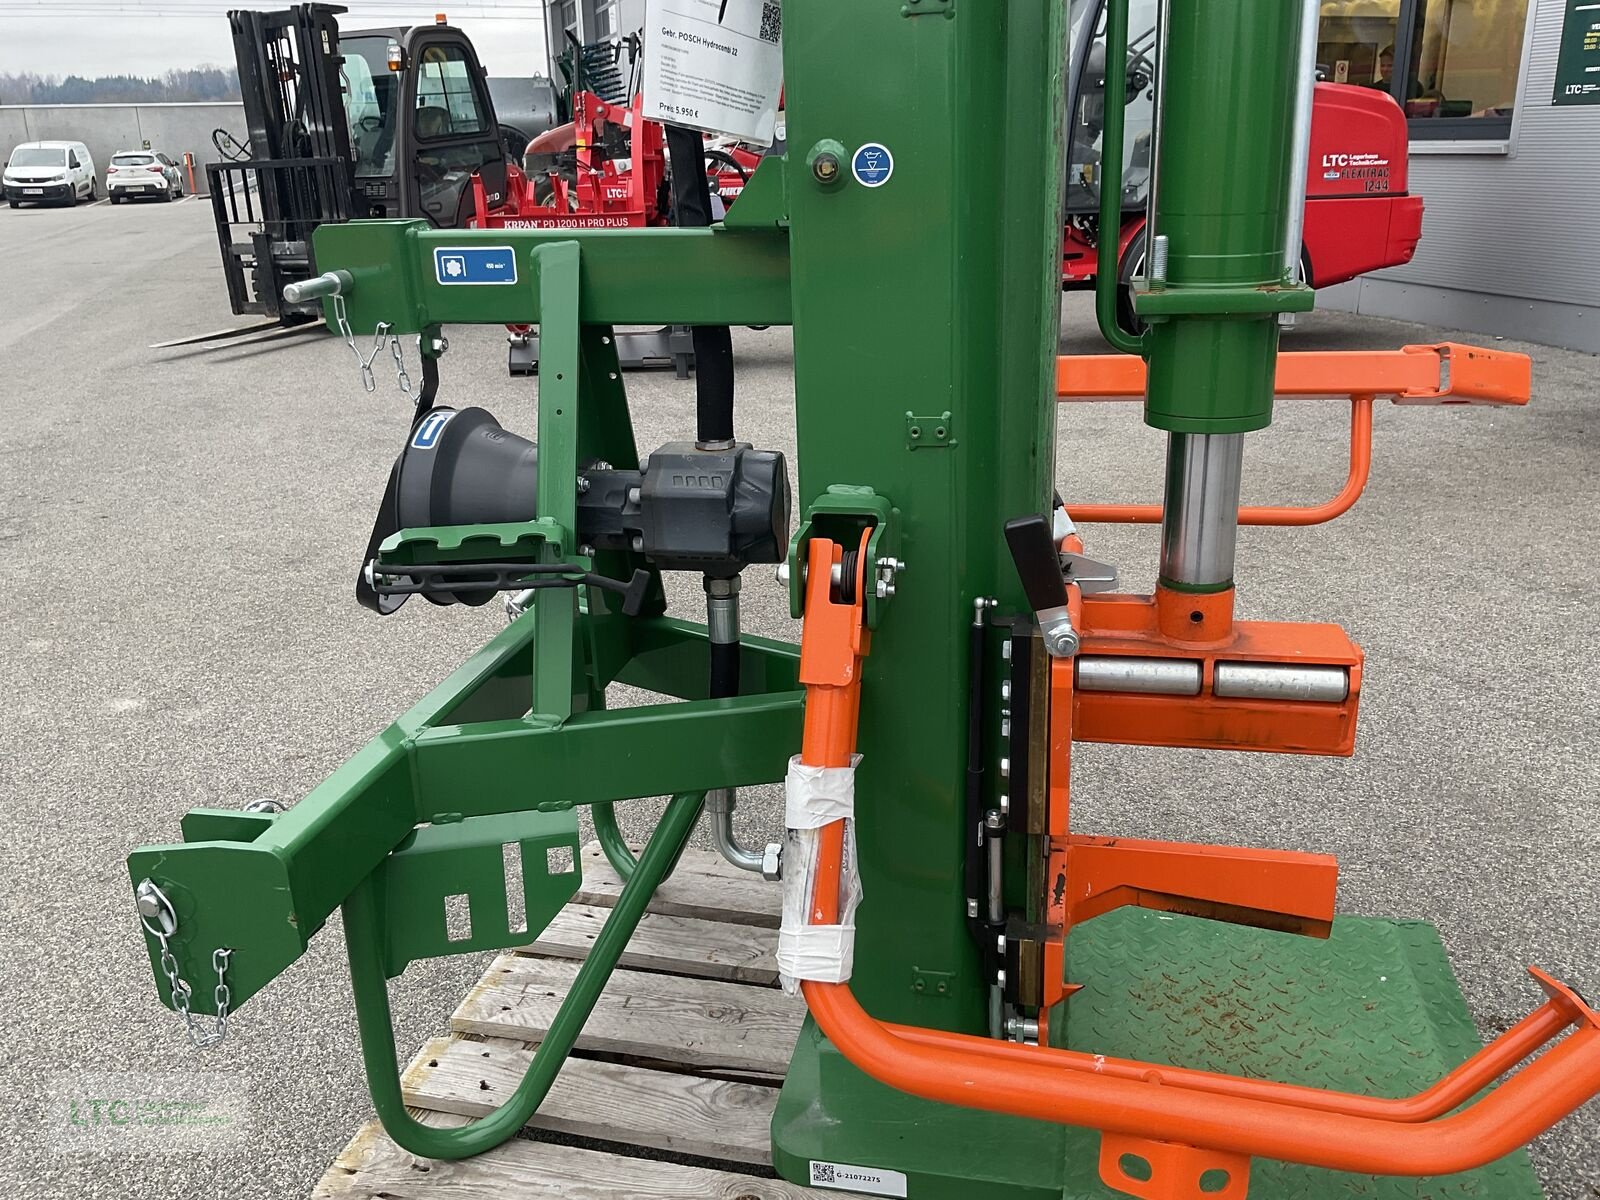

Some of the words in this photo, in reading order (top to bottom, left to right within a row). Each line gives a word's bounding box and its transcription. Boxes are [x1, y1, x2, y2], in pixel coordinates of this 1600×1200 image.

[661, 27, 677, 39] Gebr.
[678, 32, 701, 45] POSCH
[702, 38, 731, 54] Hydrocombi
[731, 47, 738, 56] 22
[1565, 84, 1582, 94] LTC
[675, 105, 694, 117] 5.950
[694, 110, 699, 118] €
[1322, 154, 1348, 167] LTC
[1341, 167, 1389, 178] FLEXITRAC
[1364, 180, 1389, 192] 1244
[606, 188, 622, 198] LTC
[543, 220, 555, 228] PD
[557, 219, 577, 228] 1200
[579, 219, 586, 227] H
[587, 219, 605, 227] PRO
[606, 217, 629, 227] PLUS
